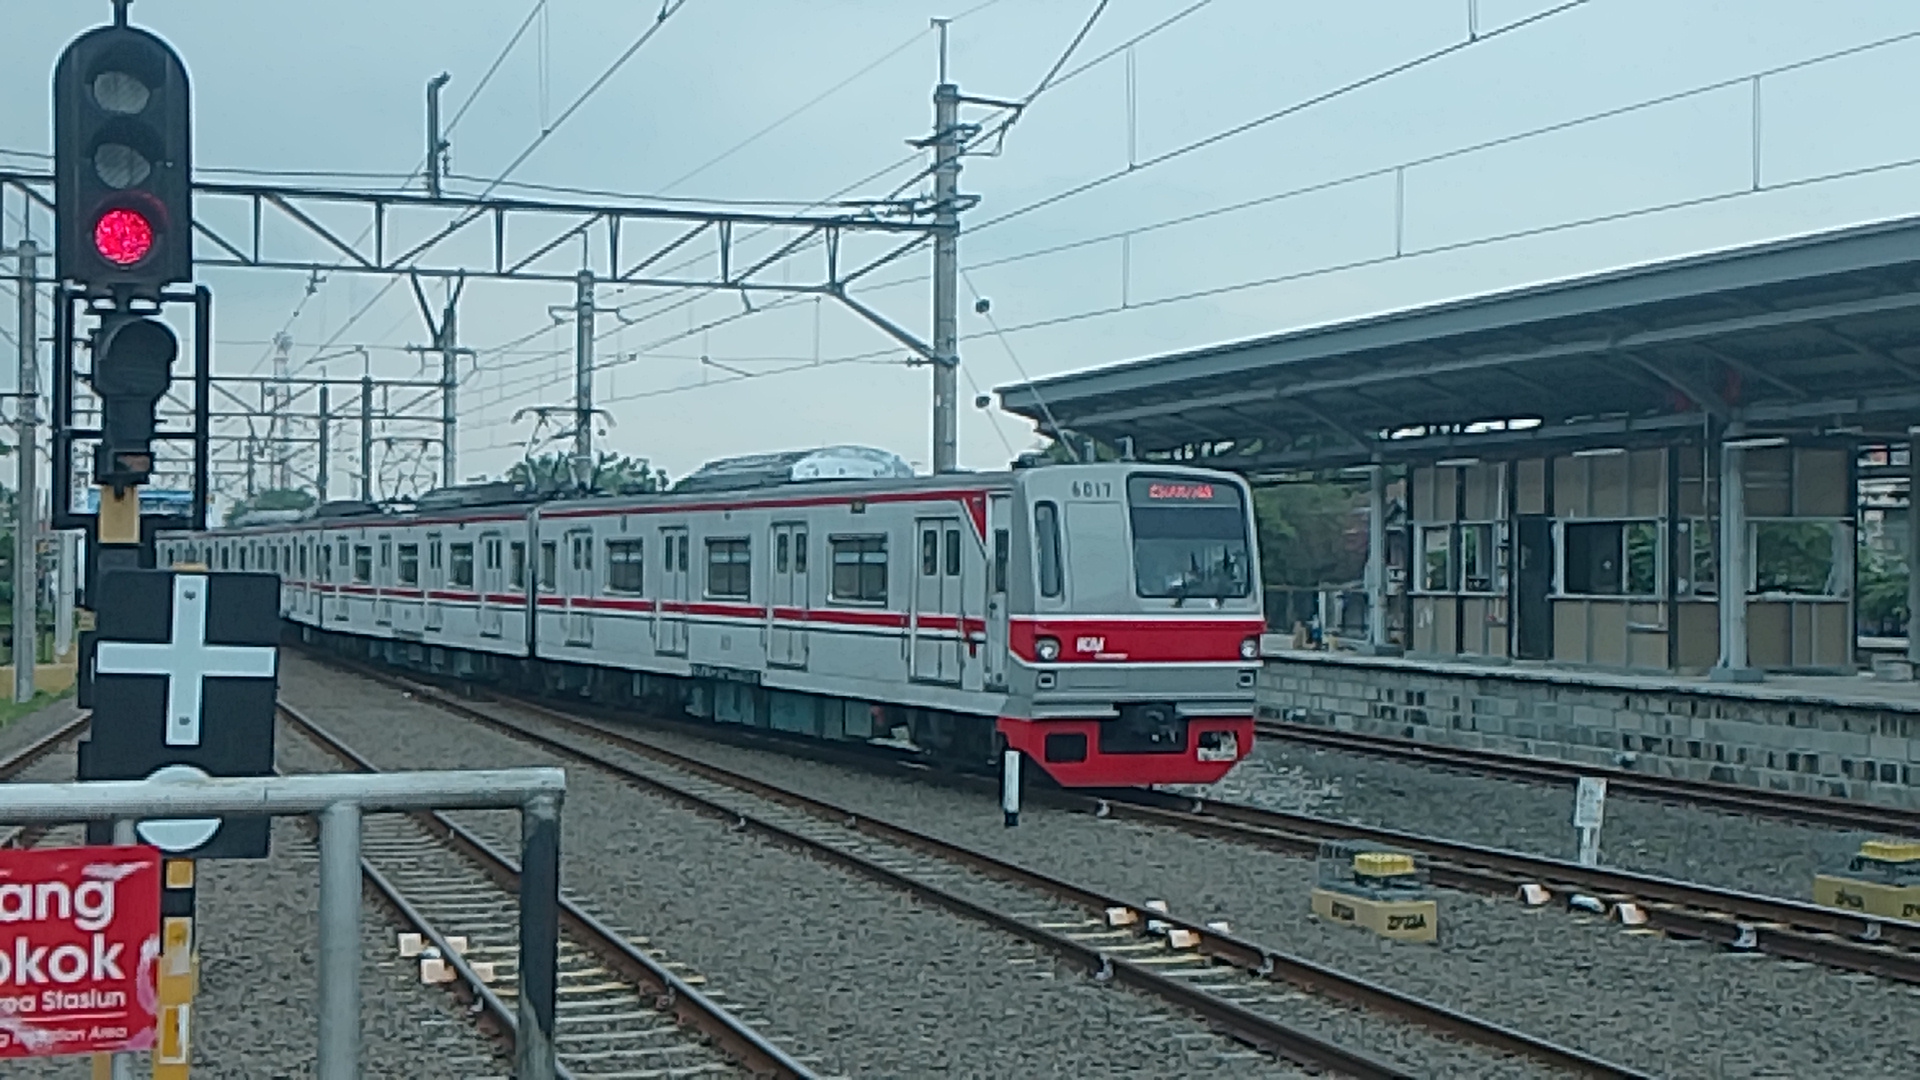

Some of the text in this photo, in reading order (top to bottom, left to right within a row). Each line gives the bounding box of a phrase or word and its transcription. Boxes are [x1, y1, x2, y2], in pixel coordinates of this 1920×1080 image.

[1071, 480, 1111, 498] 6017
[0, 881, 115, 931] ang
[0, 932, 126, 986] kok
[41, 988, 126, 1013] Stasiun
